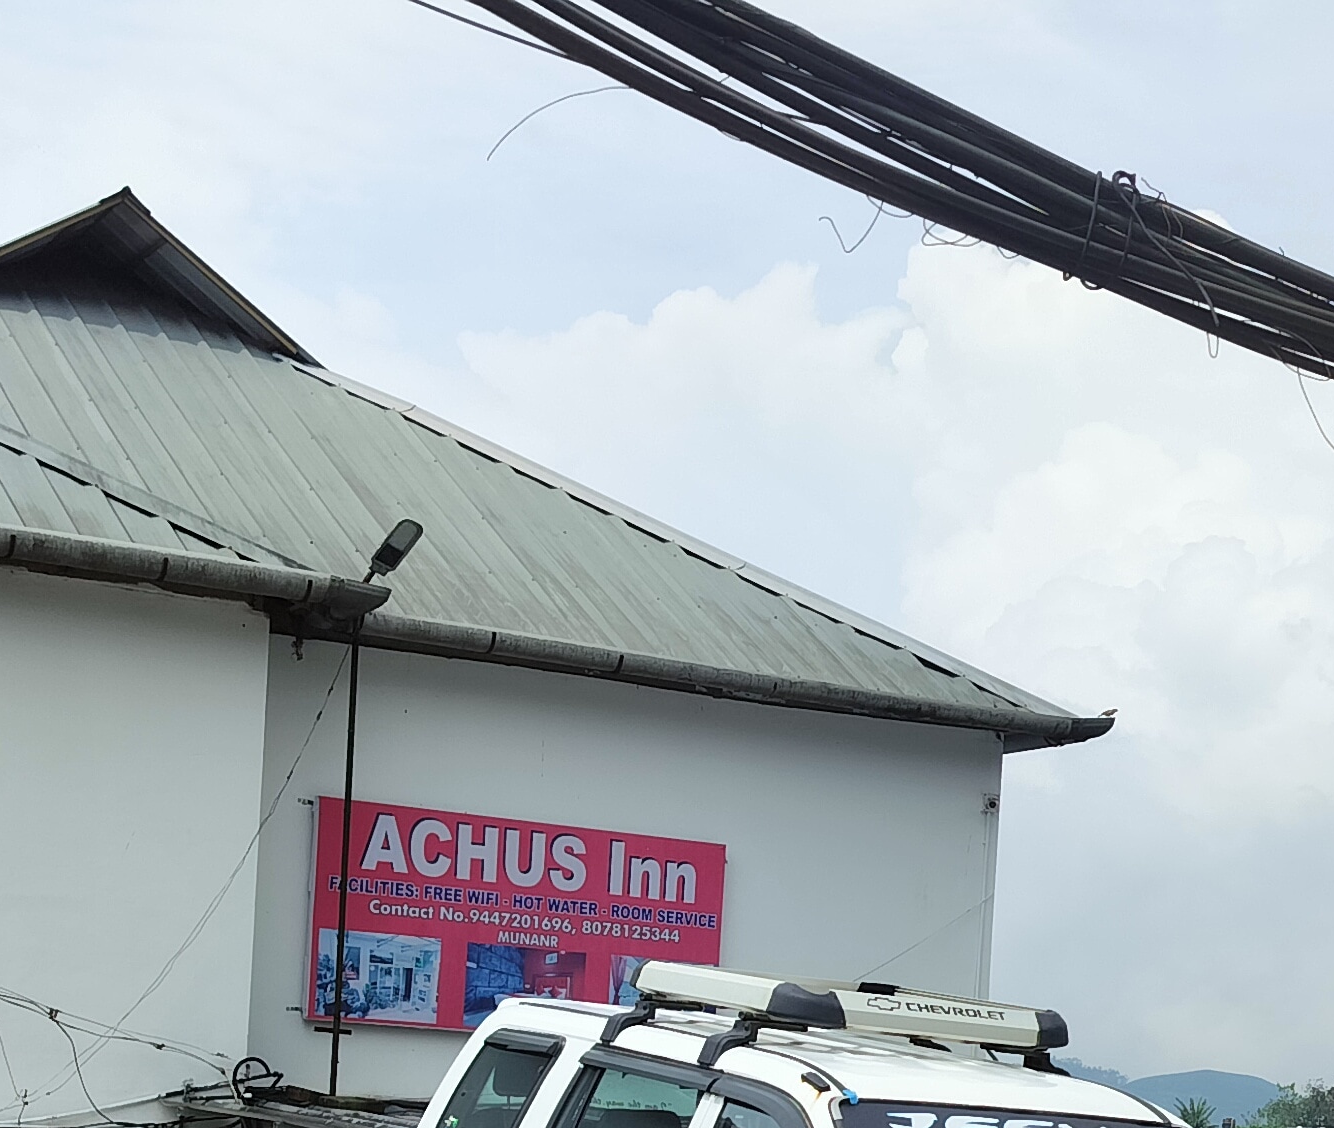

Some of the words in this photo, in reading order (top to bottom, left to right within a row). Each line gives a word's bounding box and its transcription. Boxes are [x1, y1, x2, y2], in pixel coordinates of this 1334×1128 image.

[361, 812, 587, 893] ACHUS
[608, 839, 698, 904] Inn
[369, 899, 434, 919] Contact
[581, 920, 680, 943] 8078125344
[424, 885, 463, 903] FREE
[468, 889, 499, 907] WIFI
[513, 894, 544, 912] HOT
[547, 899, 598, 916] WATER
[611, 904, 652, 921] ROOM
[657, 910, 716, 928] SERVICE
[497, 930, 559, 948] MUNANR
[905, 1002, 1005, 1021] CHEVROLET
